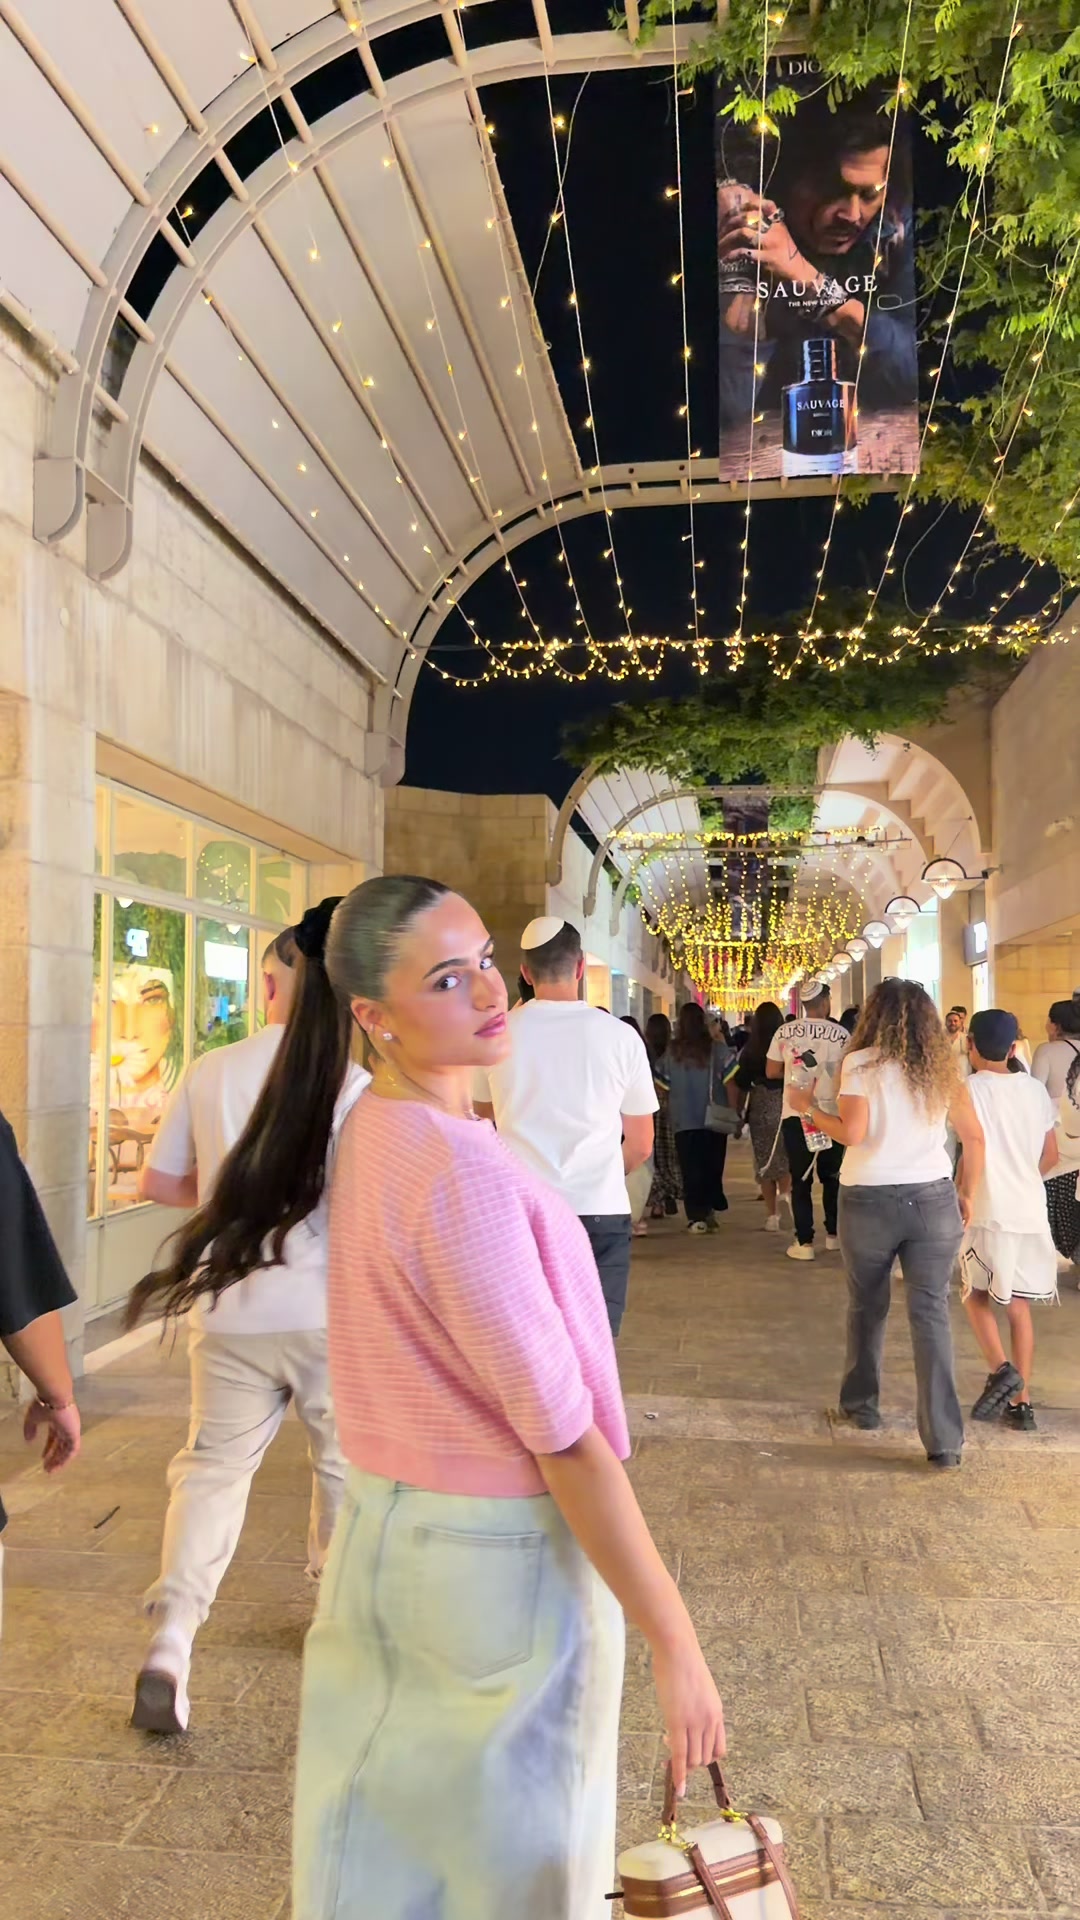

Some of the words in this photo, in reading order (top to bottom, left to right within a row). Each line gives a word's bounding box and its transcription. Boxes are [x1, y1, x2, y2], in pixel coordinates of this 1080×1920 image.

[788, 60, 823, 75] DIO
[758, 275, 878, 300] SAUVAGE
[802, 299, 819, 308] NEW
[796, 399, 845, 411] SAUVAGE
